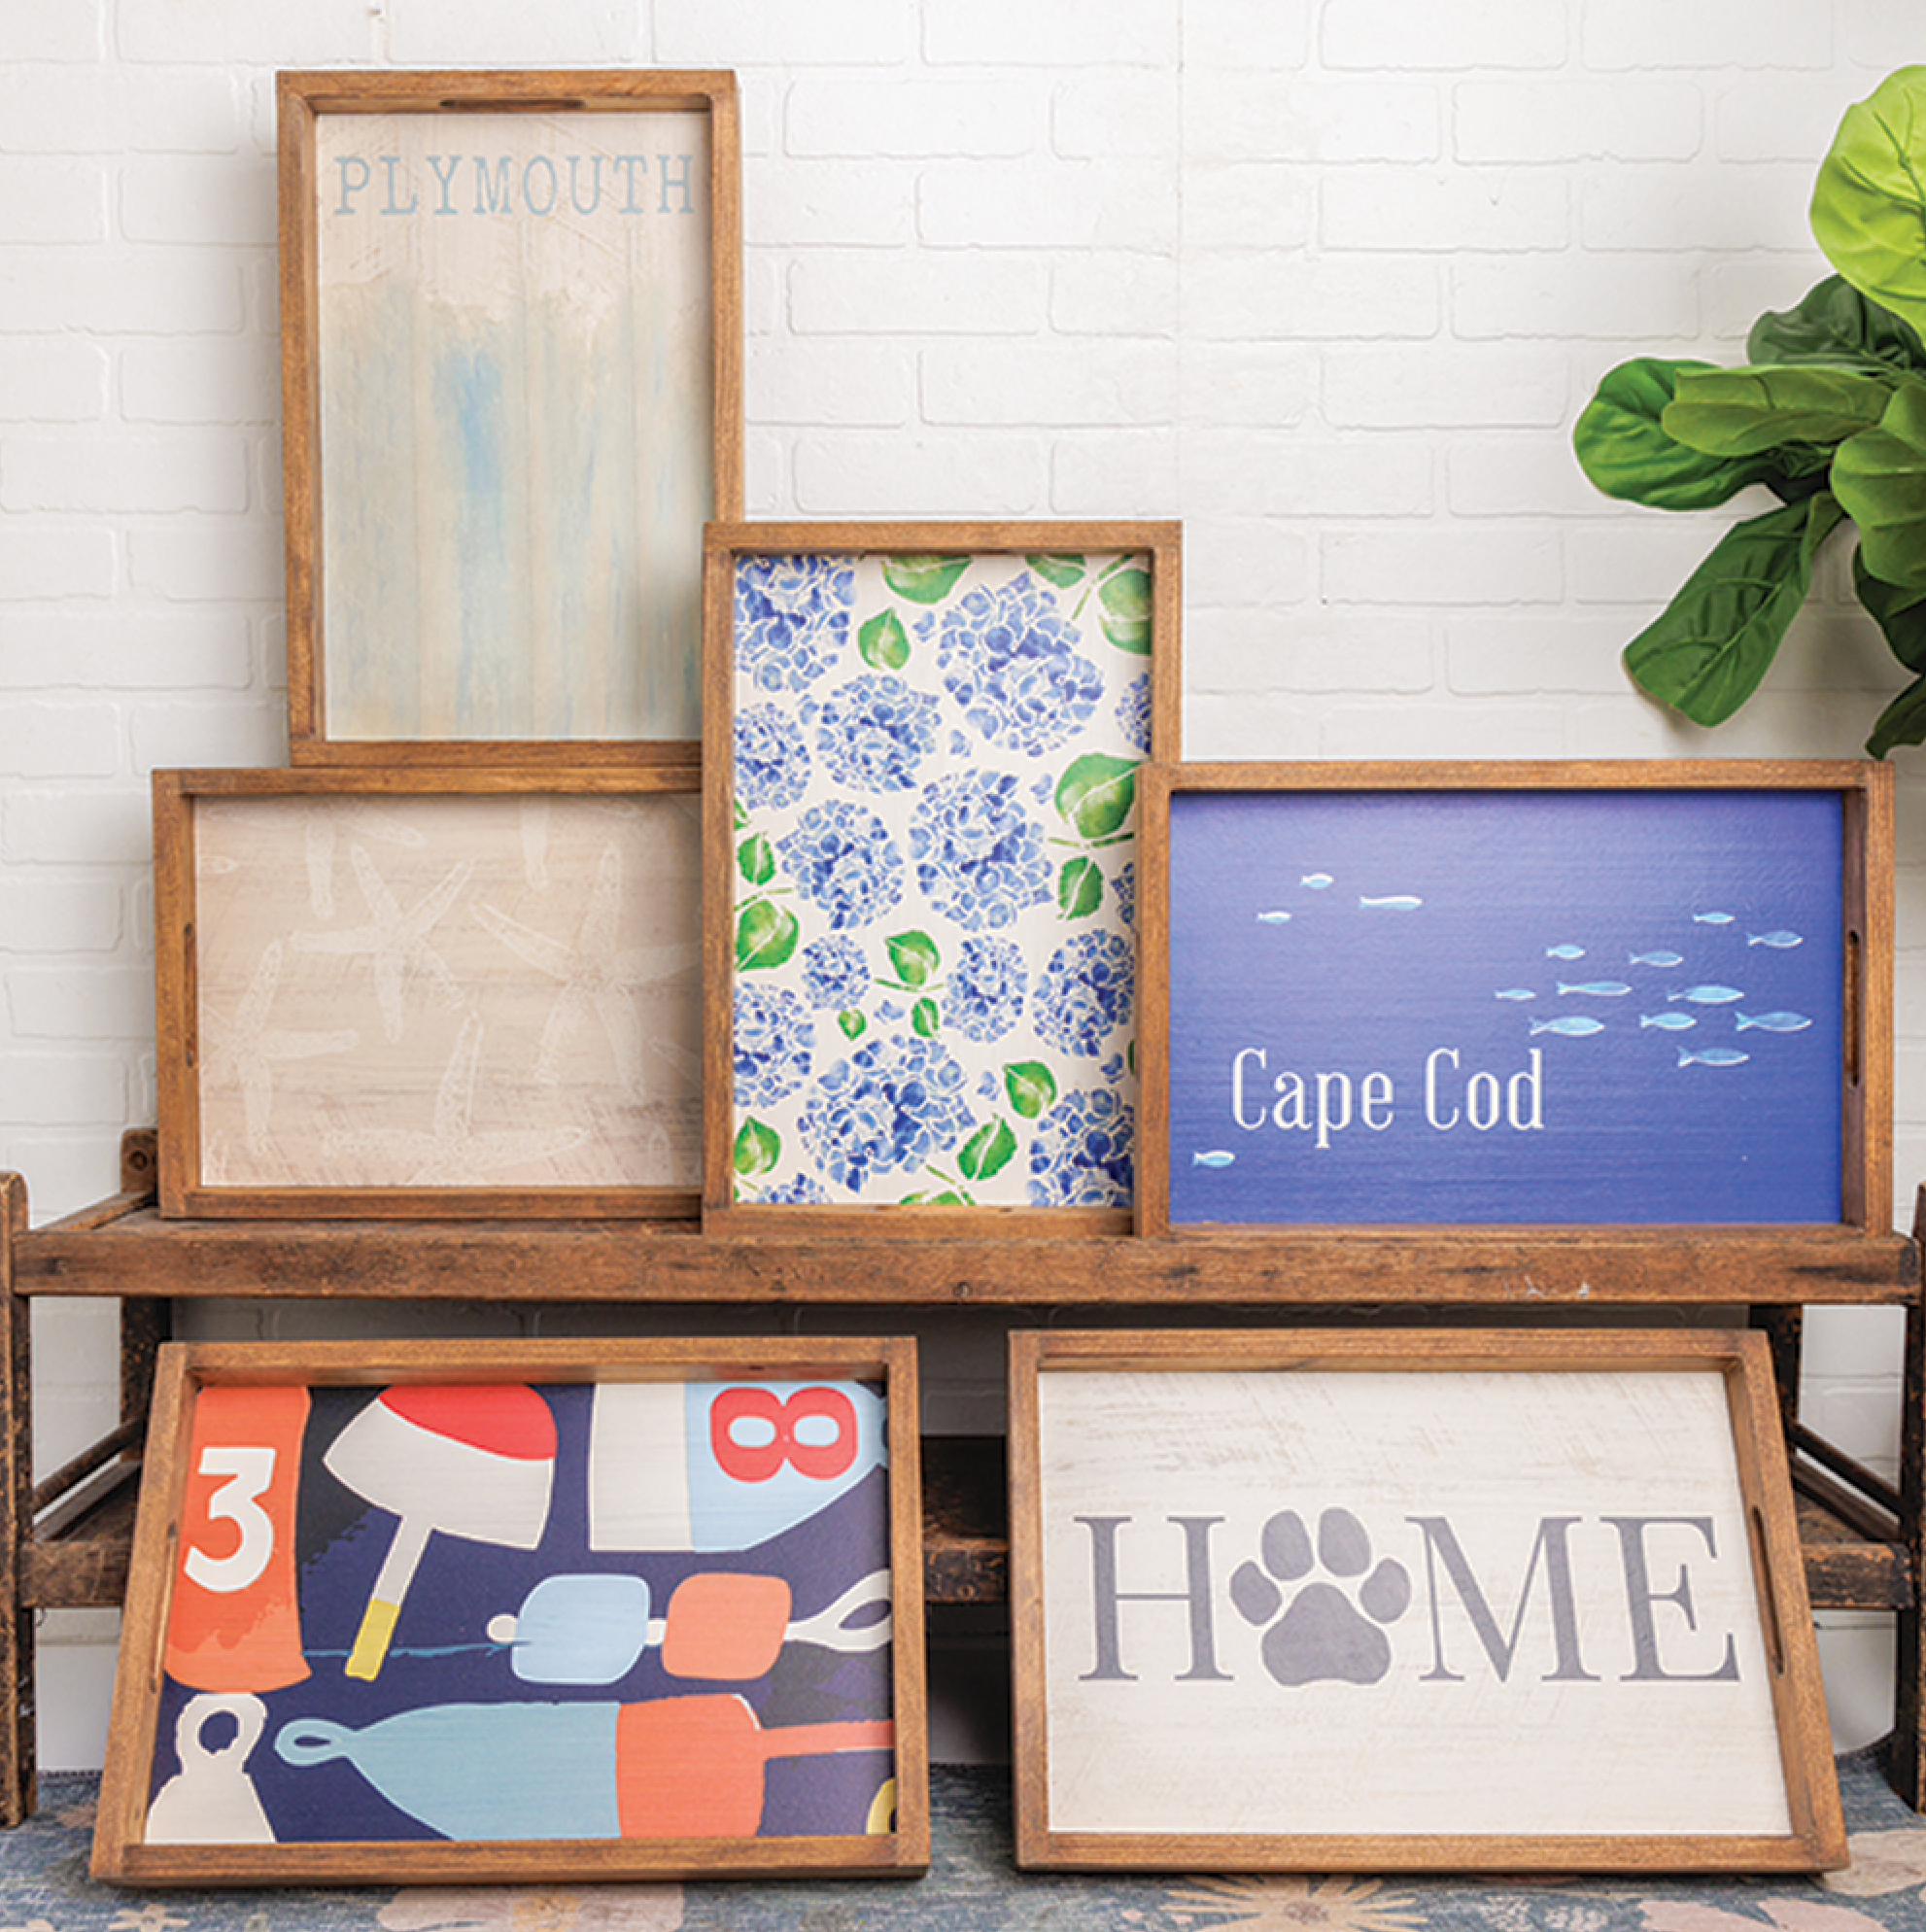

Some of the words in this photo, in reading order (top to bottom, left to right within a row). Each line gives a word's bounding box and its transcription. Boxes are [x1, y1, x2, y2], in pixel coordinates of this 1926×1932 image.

[333, 154, 695, 216] PLYMOUTH
[1232, 1048, 1393, 1148] Cape
[1426, 1048, 1544, 1130] Cod
[709, 1385, 858, 1483] 8
[184, 1446, 277, 1592] 3
[1074, 1506, 1740, 1686] HME
